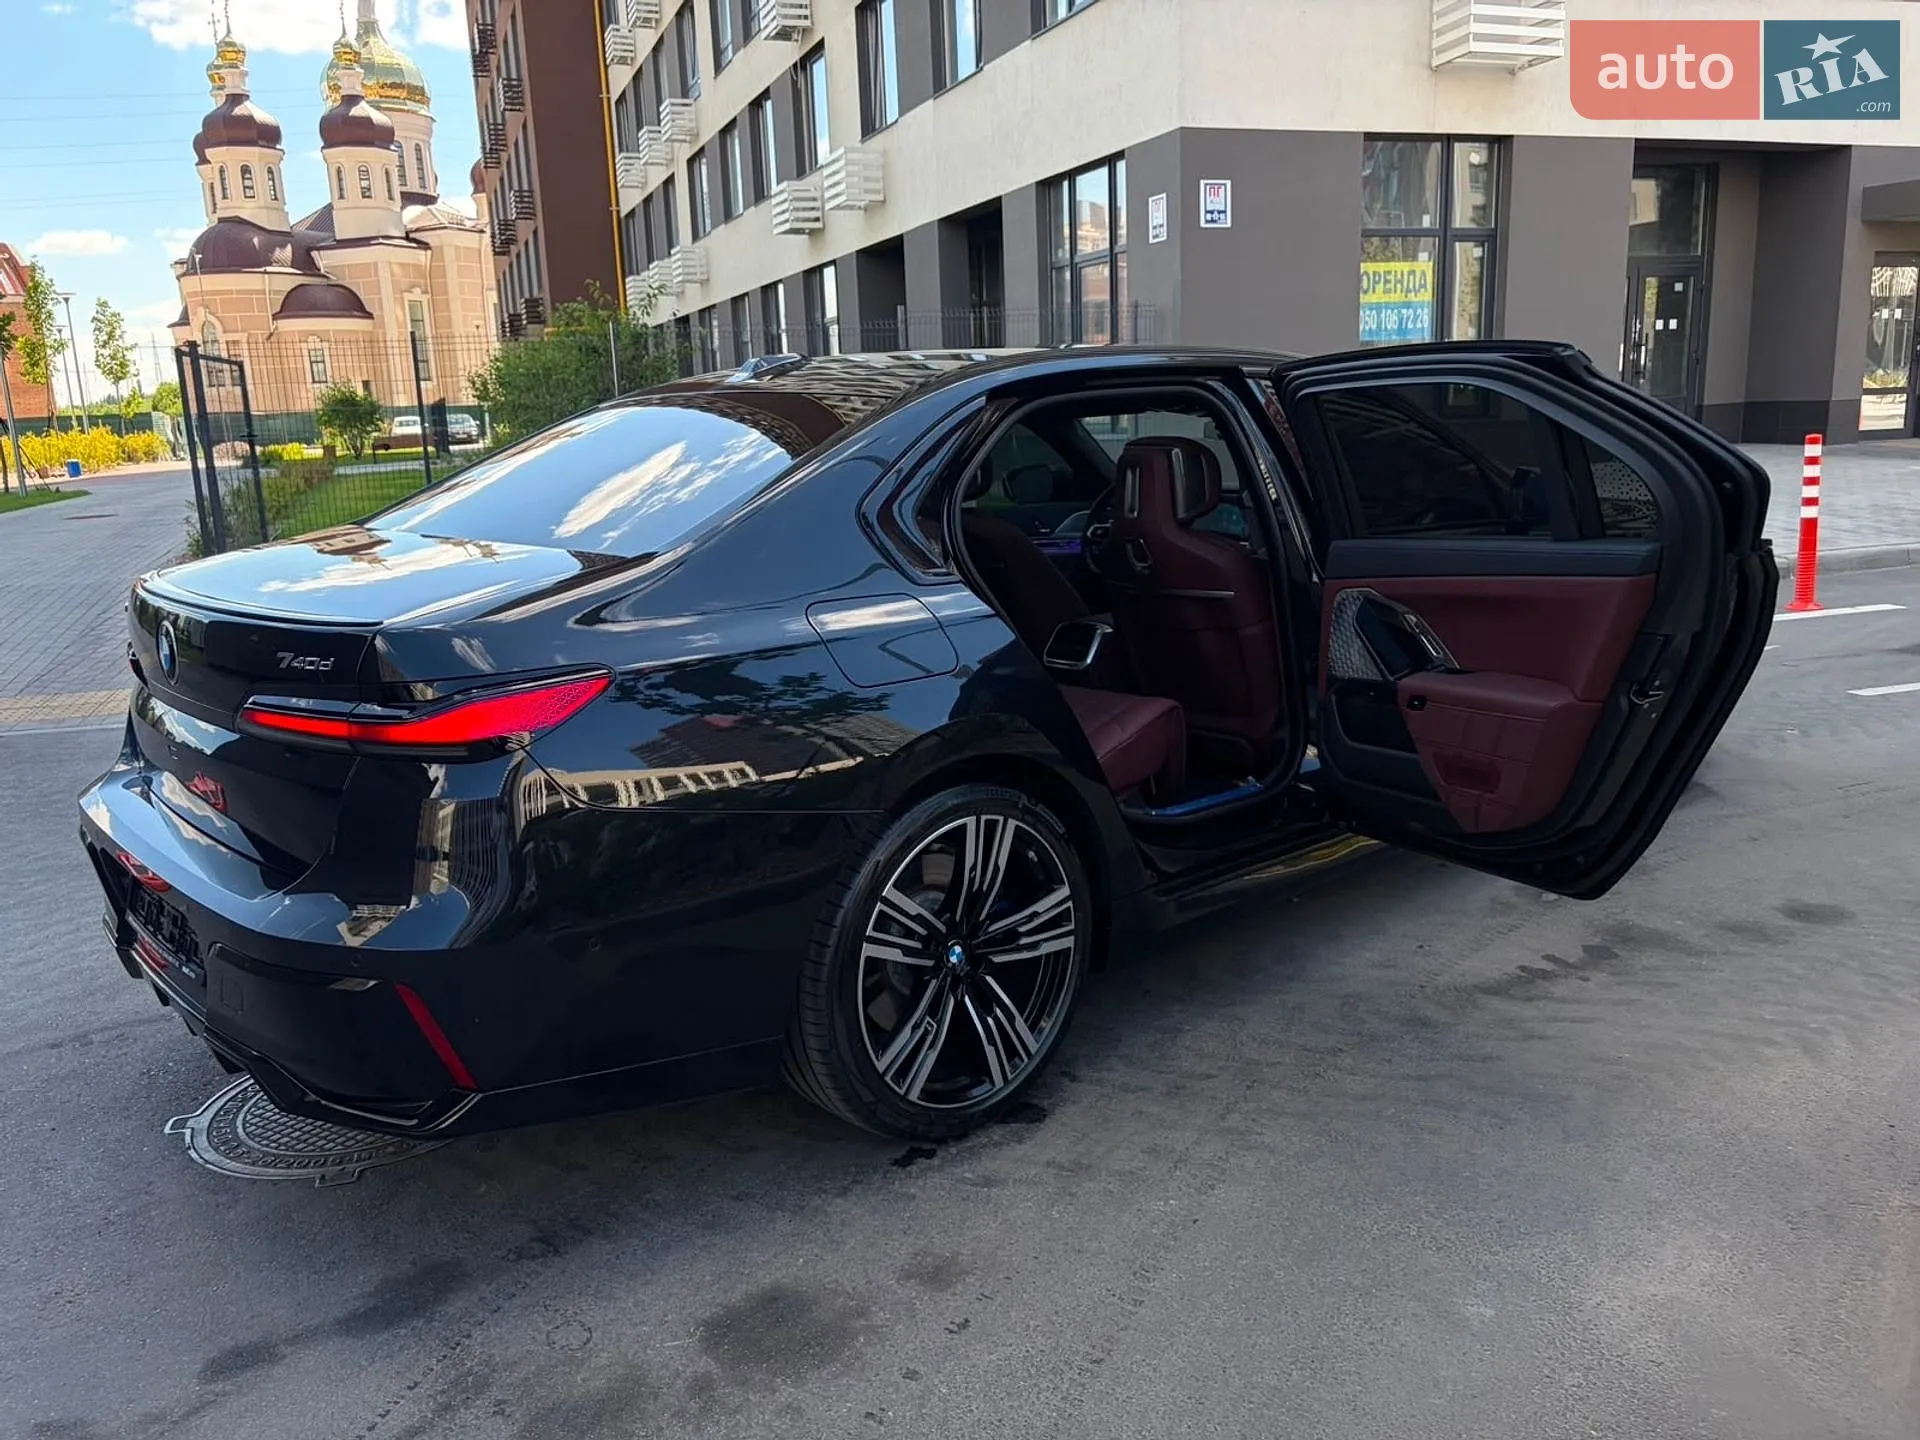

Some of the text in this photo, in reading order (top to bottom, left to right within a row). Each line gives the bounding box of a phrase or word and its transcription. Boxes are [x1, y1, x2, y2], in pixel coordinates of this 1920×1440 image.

[1360, 270, 1428, 298] ОРЕНДА
[1400, 307, 1414, 328] 72
[276, 651, 336, 671] 740d
